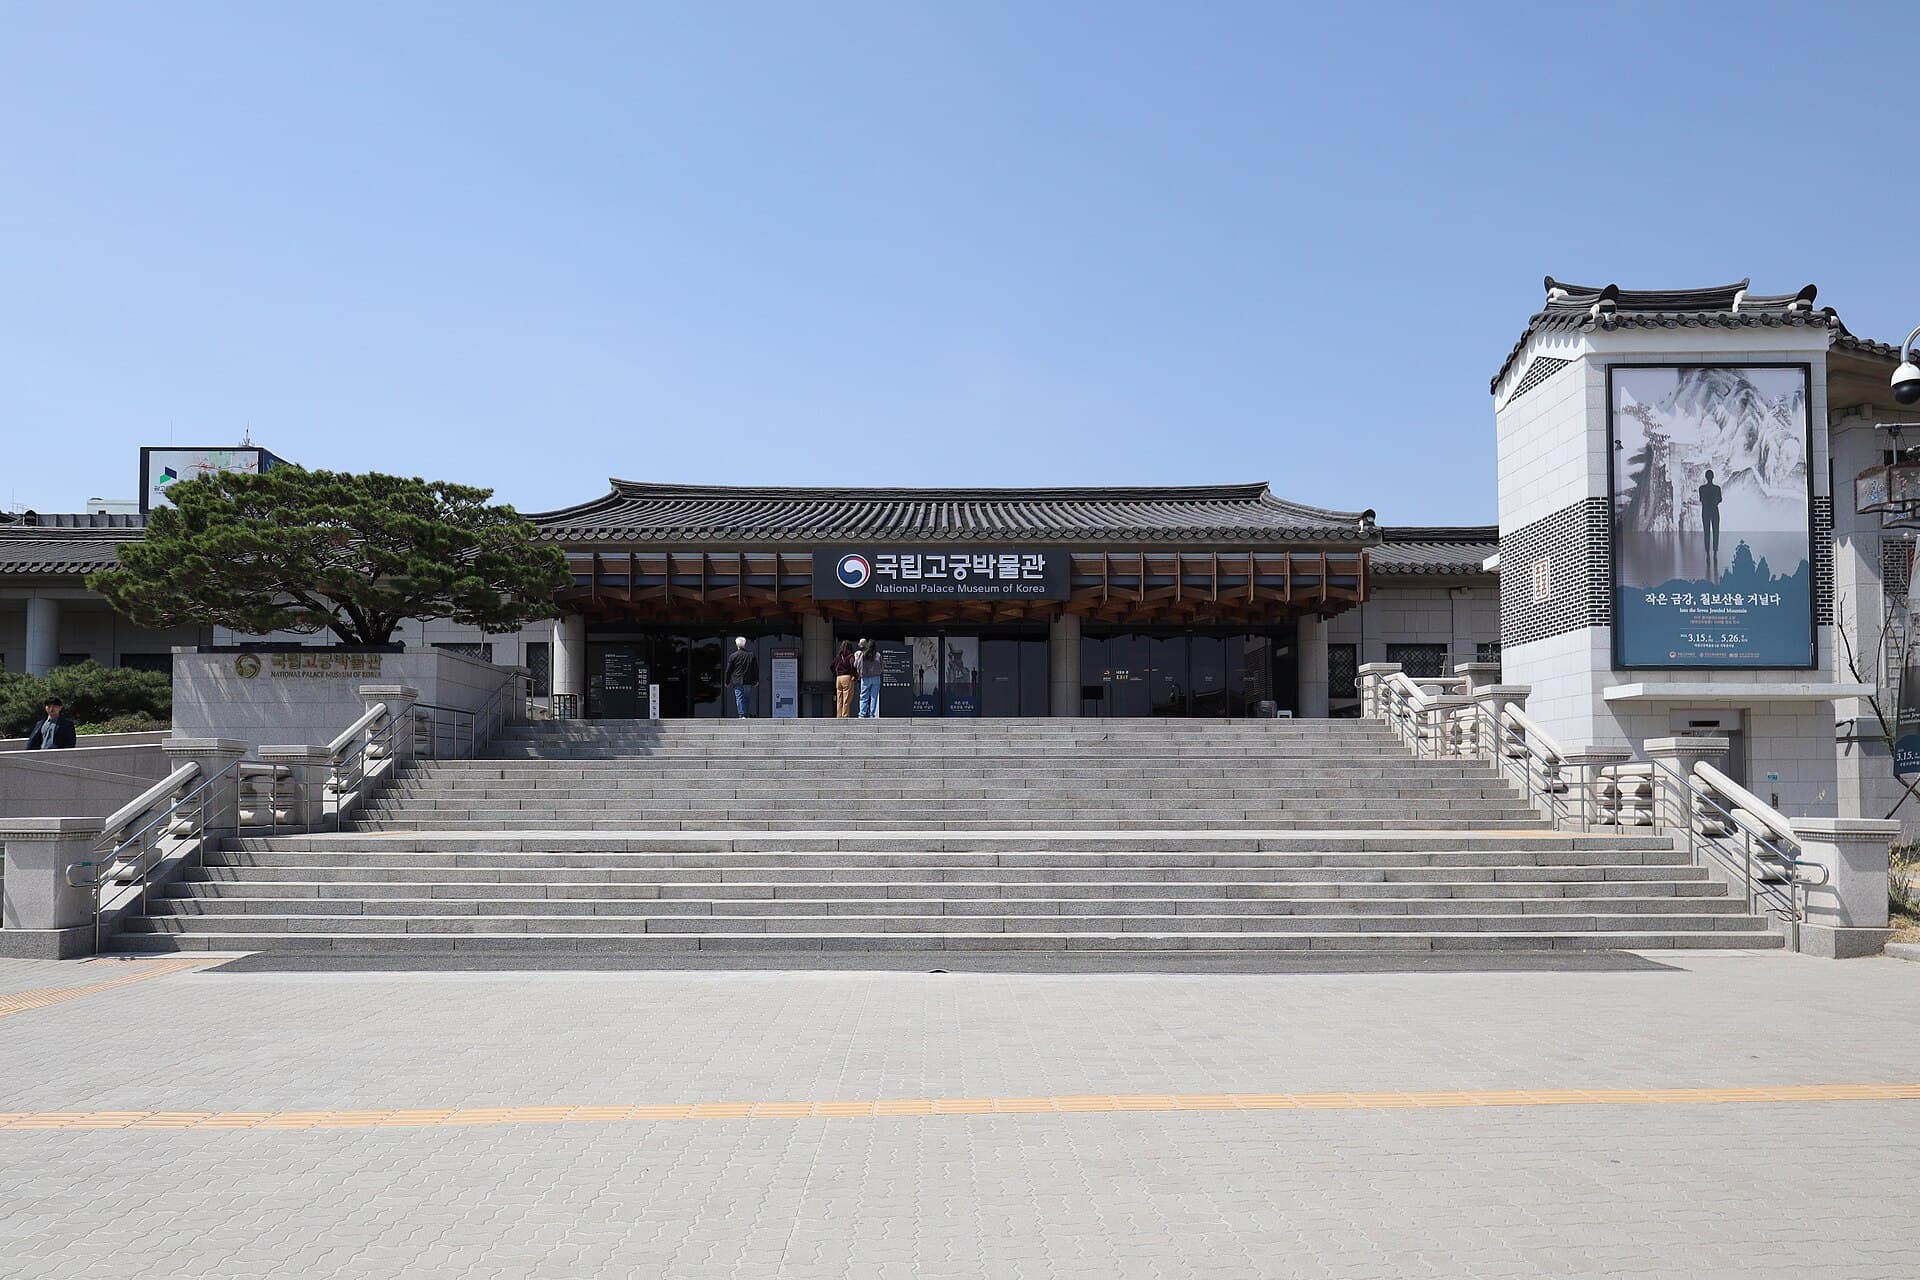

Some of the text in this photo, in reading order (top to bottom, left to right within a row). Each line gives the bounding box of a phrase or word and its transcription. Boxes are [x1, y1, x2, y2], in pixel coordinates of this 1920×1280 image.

[875, 553, 1046, 580] 국립고궁박물관
[875, 583, 1045, 593] National Palace Museum of Korea
[1645, 593, 1781, 606] 작은 금강, 칠보산을 거닐다
[1688, 633, 1708, 643] 3.15.
[1721, 633, 1741, 643] 5.26.
[271, 653, 383, 670] 국립고궁박물관
[271, 671, 302, 679] NATIONAL
[302, 671, 325, 679] PALACE
[353, 671, 361, 679] OF
[1896, 751, 1914, 762] 3.15.
